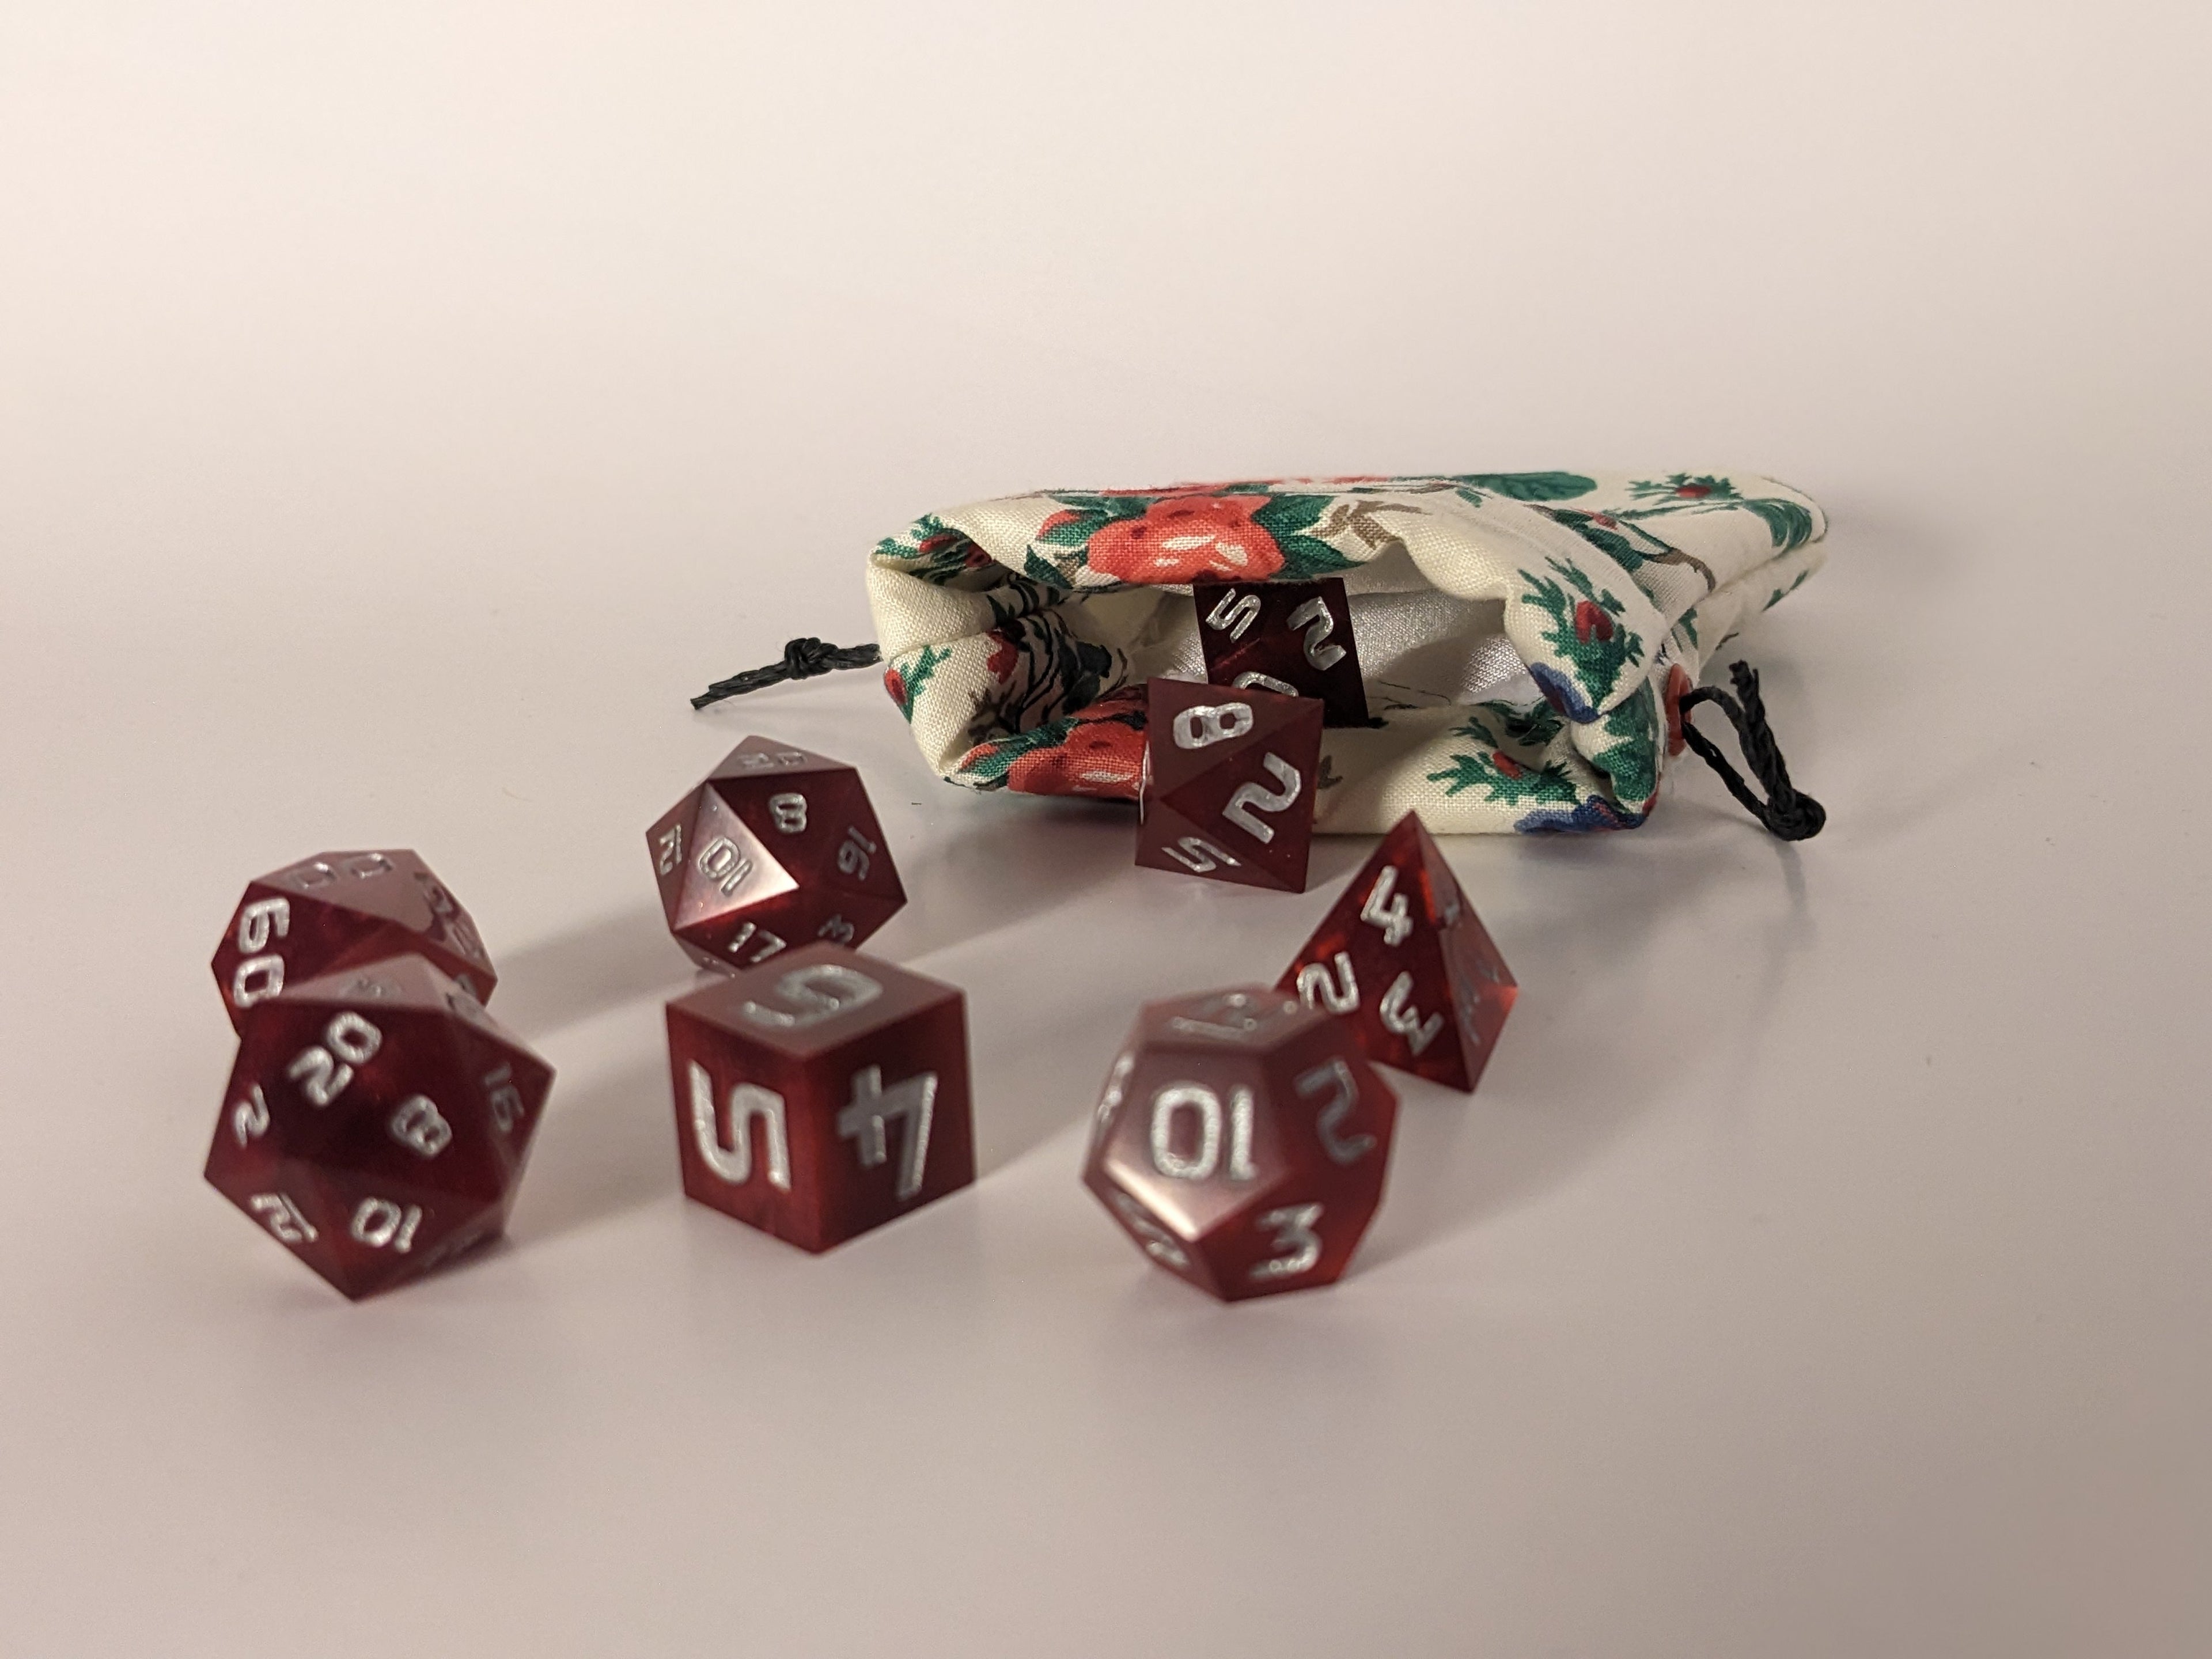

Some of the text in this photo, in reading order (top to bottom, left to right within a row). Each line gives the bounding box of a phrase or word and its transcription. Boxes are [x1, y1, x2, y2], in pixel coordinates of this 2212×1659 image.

[1205, 588, 1262, 643] 5
[1286, 596, 1347, 671] 2
[1173, 702, 1253, 749] 8
[768, 792, 808, 834] 8
[1222, 751, 1302, 844] 2
[1161, 837, 1242, 873] 5
[1360, 865, 1414, 946] 4
[728, 922, 787, 963] 17
[1296, 951, 1361, 1014] 2
[1378, 971, 1445, 1056] 3
[287, 1010, 383, 1108] 20
[235, 1083, 270, 1150] 2
[391, 1094, 452, 1158] 8
[688, 1058, 792, 1194] 5
[836, 1063, 939, 1203] 4
[1248, 1202, 1325, 1281] 3
